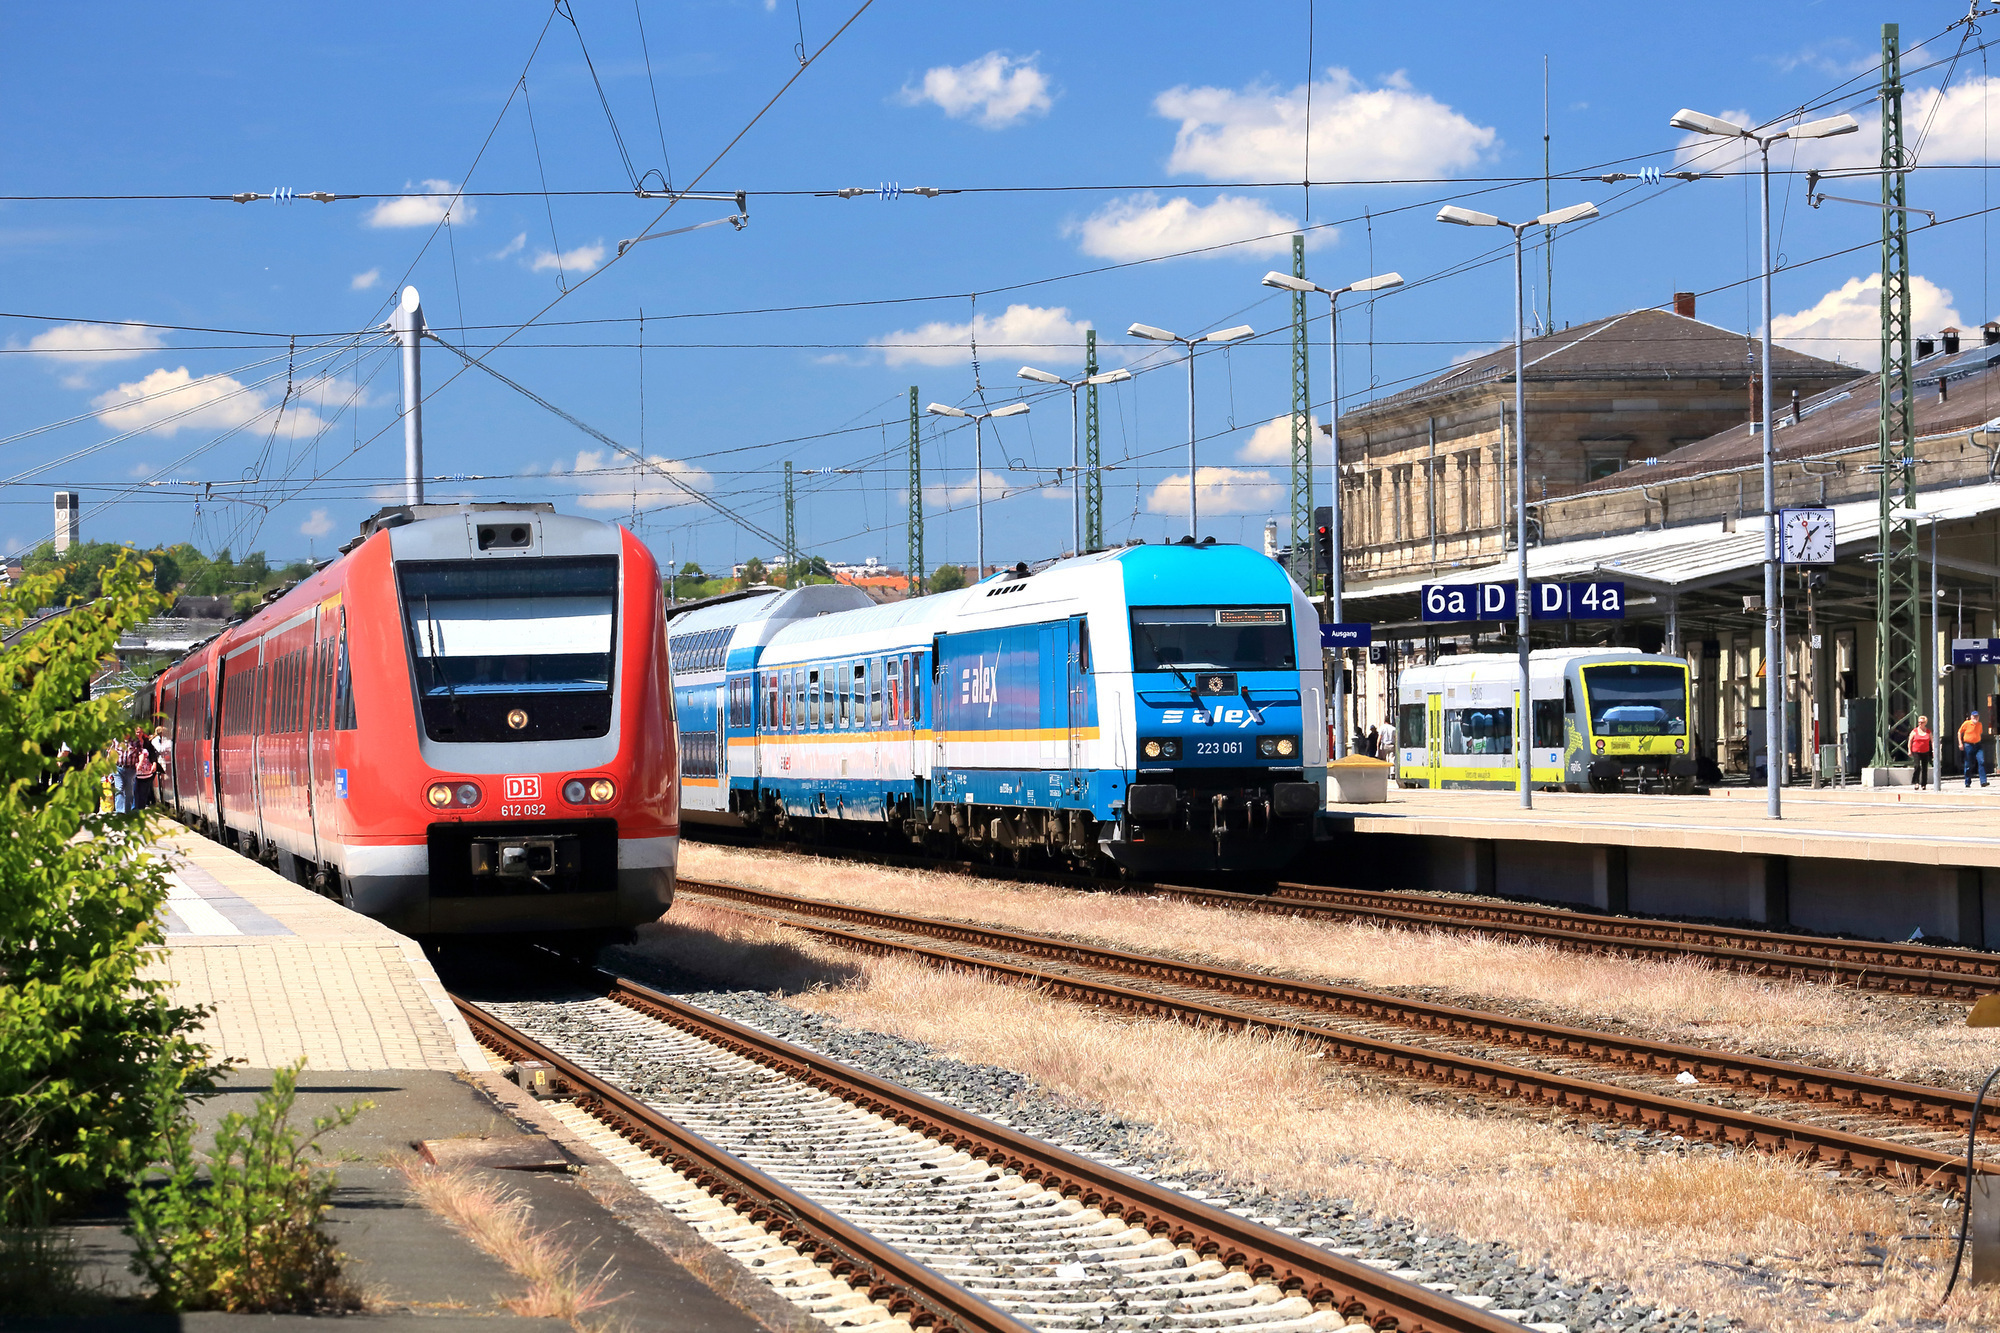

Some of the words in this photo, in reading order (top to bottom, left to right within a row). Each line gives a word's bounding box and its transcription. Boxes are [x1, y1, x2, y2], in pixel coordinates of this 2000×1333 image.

[1427, 585, 1465, 613] 6a
[1484, 584, 1506, 612] D
[1541, 583, 1563, 611] D
[1581, 583, 1620, 611] 4a
[1331, 630, 1358, 638] Ausgang
[1371, 647, 1381, 661] B
[972, 639, 1003, 718] alex
[1191, 702, 1276, 728] alex
[1617, 724, 1632, 733] Bad
[1197, 742, 1220, 755] 223
[1222, 741, 1243, 754] 061
[509, 779, 537, 796] DB
[501, 804, 521, 817] 612
[524, 803, 546, 816] 092
